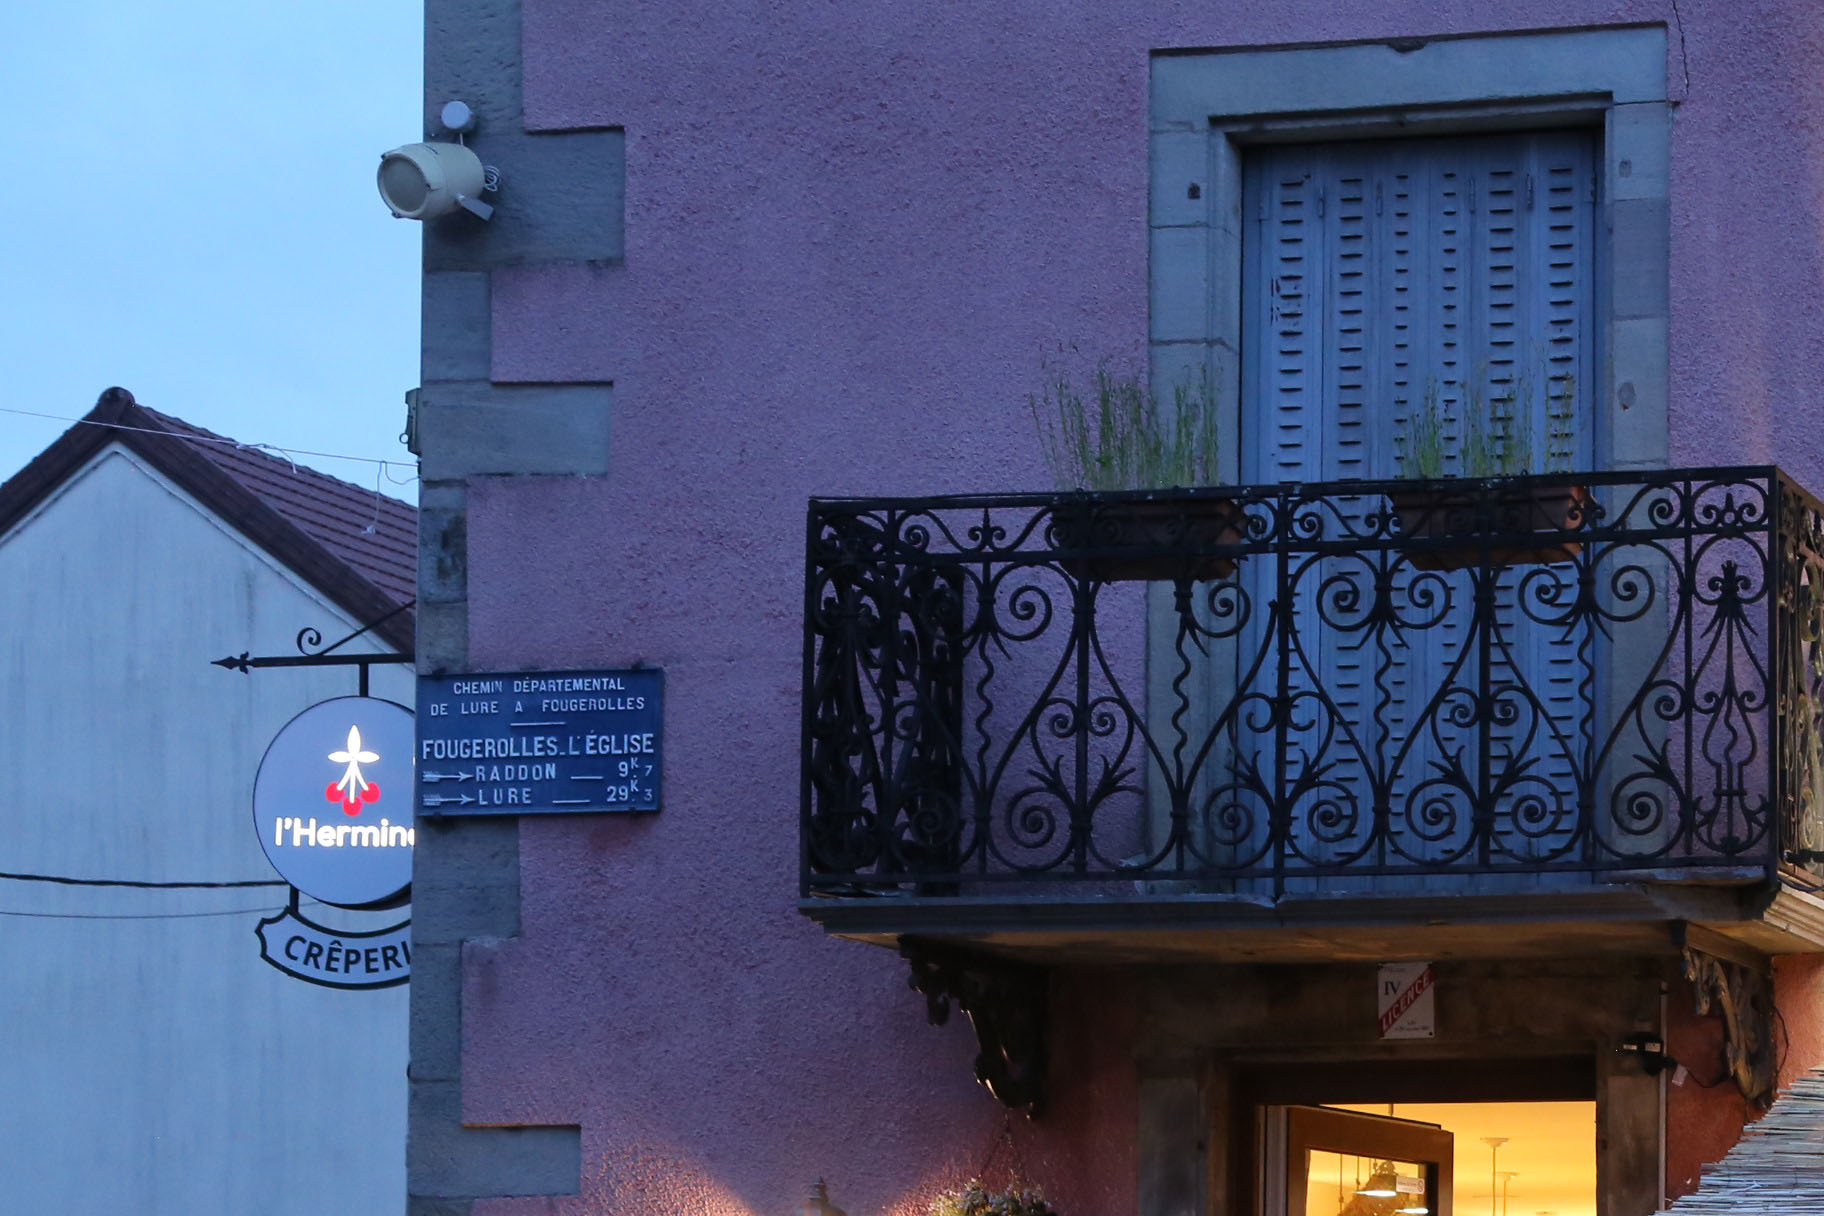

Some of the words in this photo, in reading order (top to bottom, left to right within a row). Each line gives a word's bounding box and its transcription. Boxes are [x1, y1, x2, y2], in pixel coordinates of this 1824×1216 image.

[453, 681, 503, 694] CHEMIN
[513, 677, 625, 693] DÉPARTEMENTAL
[430, 703, 448, 716] DE
[461, 701, 499, 715] LURE
[542, 697, 645, 713] FOUGEROLLES
[475, 763, 556, 782] RADDON
[478, 788, 532, 805] LURE
[284, 934, 411, 974] CRÊPERI
